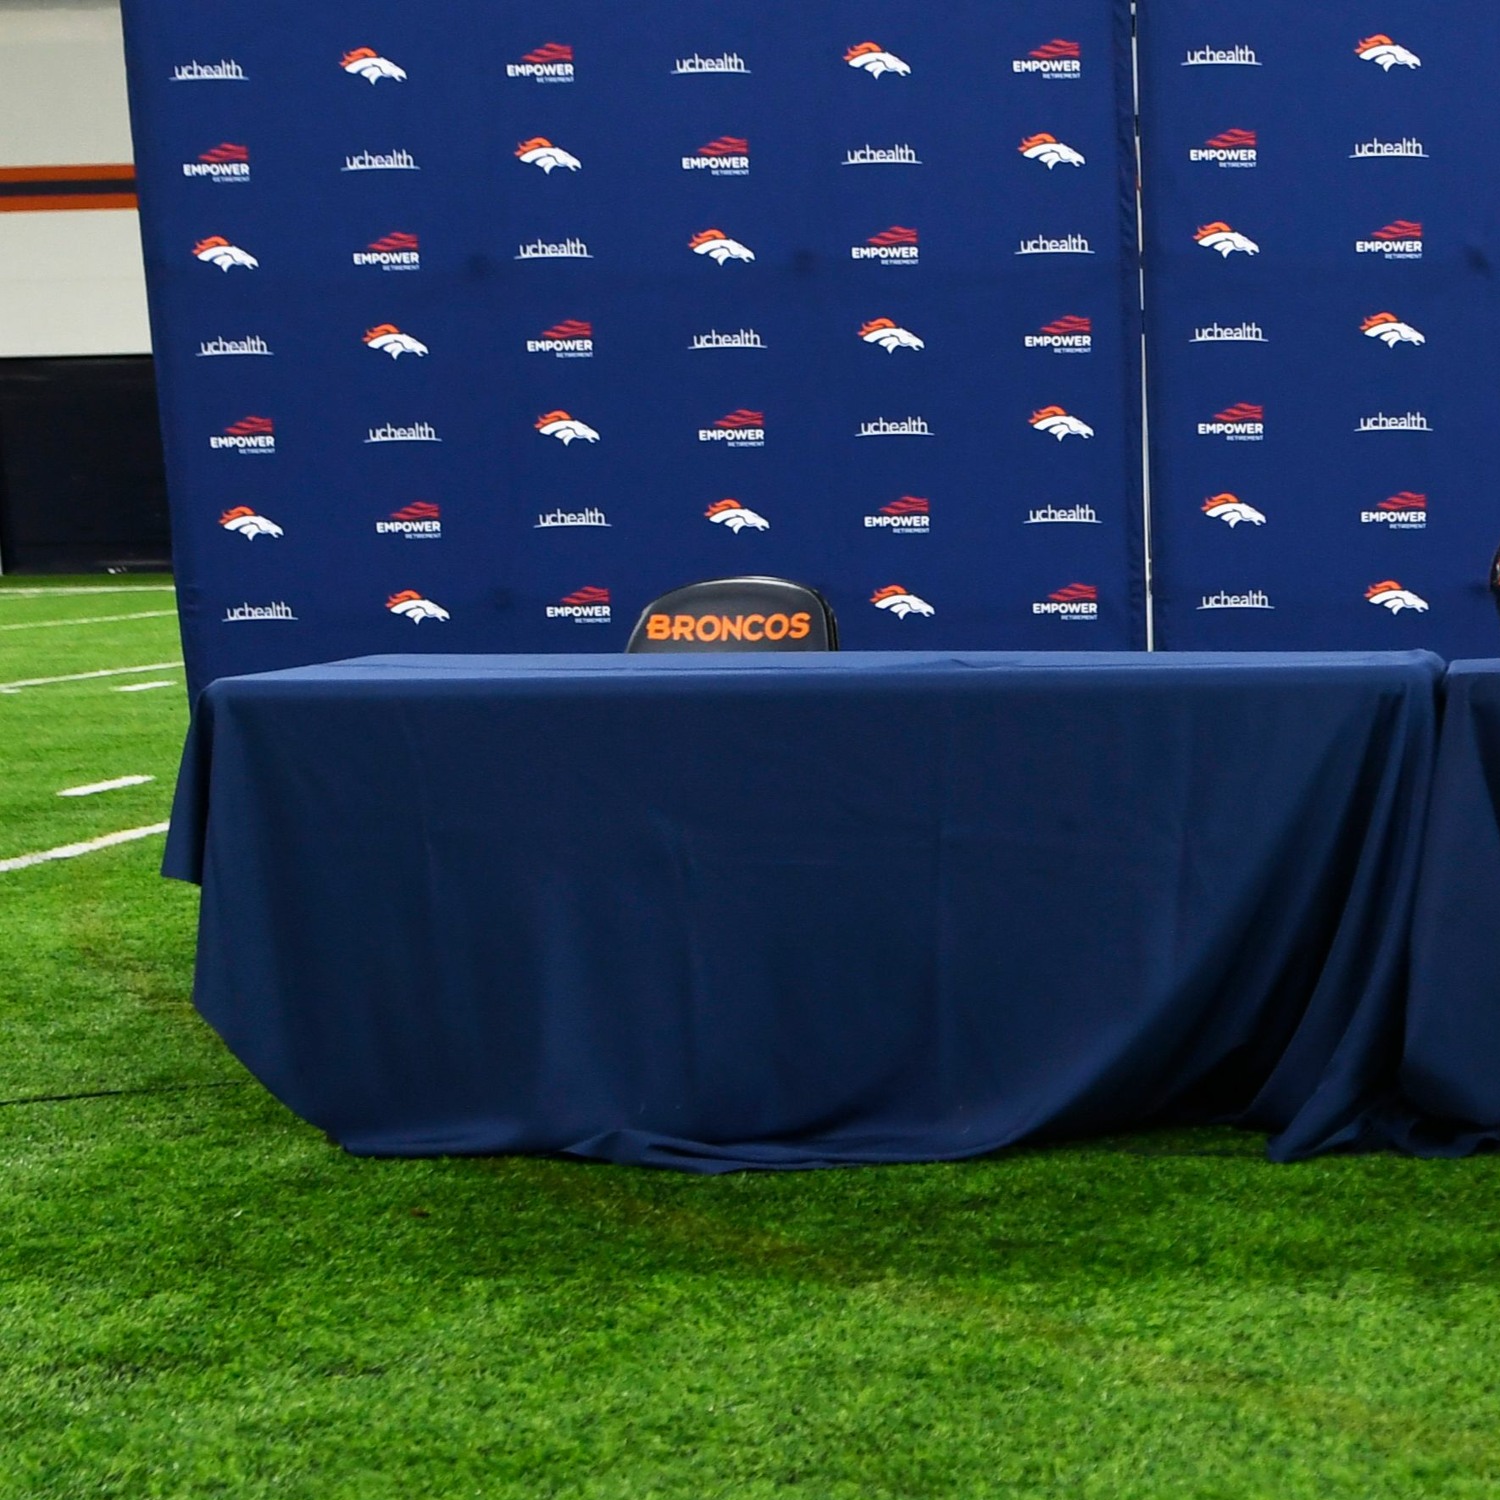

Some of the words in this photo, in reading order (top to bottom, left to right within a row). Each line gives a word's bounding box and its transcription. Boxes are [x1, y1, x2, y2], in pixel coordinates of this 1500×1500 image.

[676, 52, 745, 70] uchealth
[1187, 44, 1256, 62] uchealth
[174, 59, 243, 77] uchealth
[506, 63, 574, 77] EMPOWER
[1012, 59, 1081, 73] EMPOWER
[847, 143, 916, 161] uchealth
[1189, 148, 1257, 161] EMPOWER
[1354, 137, 1423, 155] uchealth
[345, 149, 414, 167] uchealth
[681, 156, 750, 170] EMPOWER
[182, 163, 250, 176] EMPOWER
[519, 237, 587, 256] uchealth
[1020, 233, 1089, 251] uchealth
[1355, 240, 1423, 253] EMPOWER
[352, 251, 420, 265] EMPOWER
[851, 246, 919, 259] EMPOWER
[693, 328, 761, 346] uchealth
[1195, 322, 1263, 339] uchealth
[200, 335, 268, 353] uchealth
[526, 339, 593, 352] EMPOWER
[1024, 334, 1092, 348] EMPOWER
[860, 416, 928, 433] uchealth
[1360, 411, 1427, 428] uchealth
[369, 422, 436, 439] uchealth
[698, 428, 765, 441] EMPOWER
[1197, 422, 1264, 435] EMPOWER
[209, 435, 275, 449] EMPOWER
[539, 507, 606, 524] uchealth
[1029, 503, 1096, 520] uchealth
[1360, 511, 1427, 523] EMPOWER
[375, 520, 441, 533] EMPOWER
[863, 515, 930, 528] EMPOWER
[1202, 589, 1269, 606] uchealth
[226, 601, 292, 618] uchealth
[545, 605, 611, 618] EMPOWER
[1032, 602, 1098, 614] EMPOWER
[646, 611, 811, 642] BRONCOS
